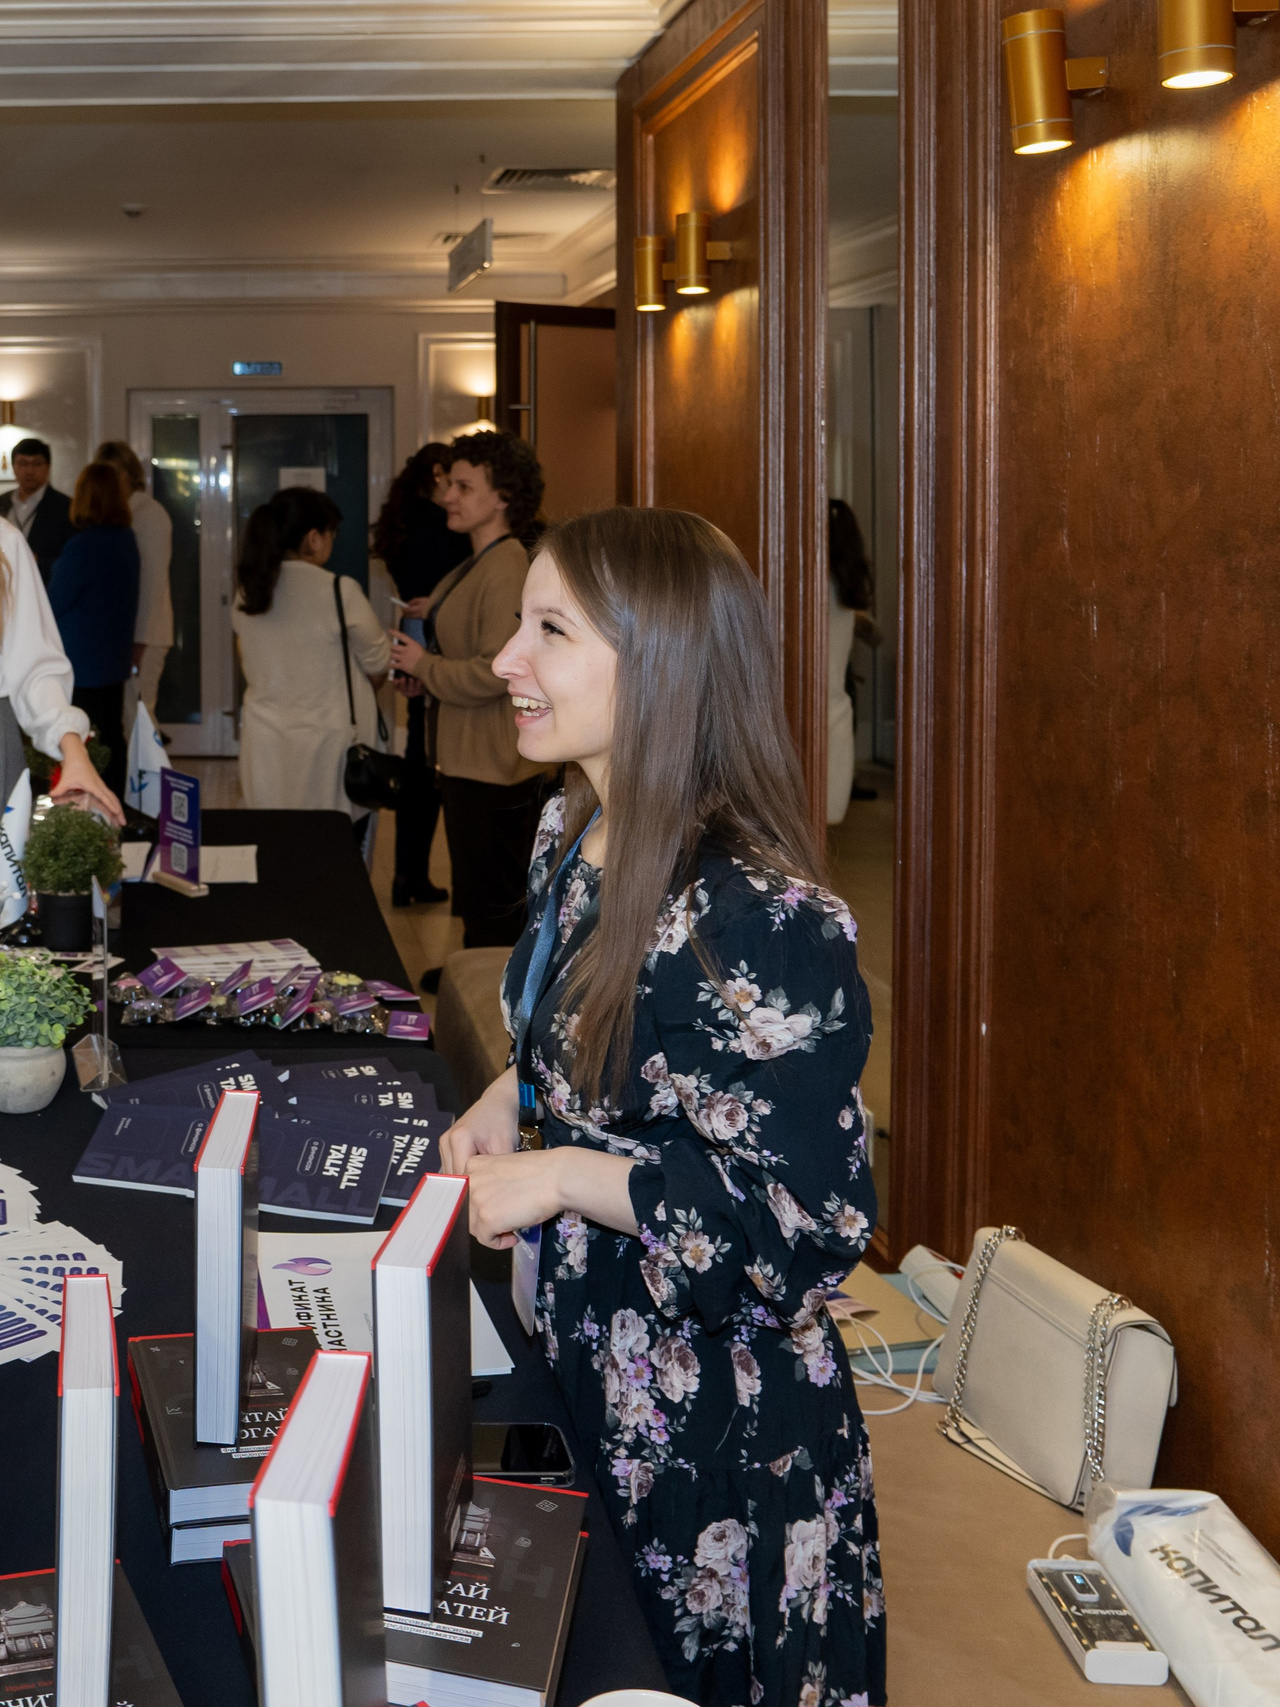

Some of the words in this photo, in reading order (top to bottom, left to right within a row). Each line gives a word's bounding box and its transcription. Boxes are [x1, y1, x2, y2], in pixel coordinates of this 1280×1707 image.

[322, 1143, 348, 1177] TALK
[339, 1146, 368, 1190] SMALL
[396, 1136, 430, 1176] SMALL
[288, 1279, 318, 1332] ИФИКАТ
[313, 1286, 347, 1351] АСТНИКА
[384, 1622, 470, 1643] редпринимателя
[437, 1600, 510, 1626] АТЕЙ
